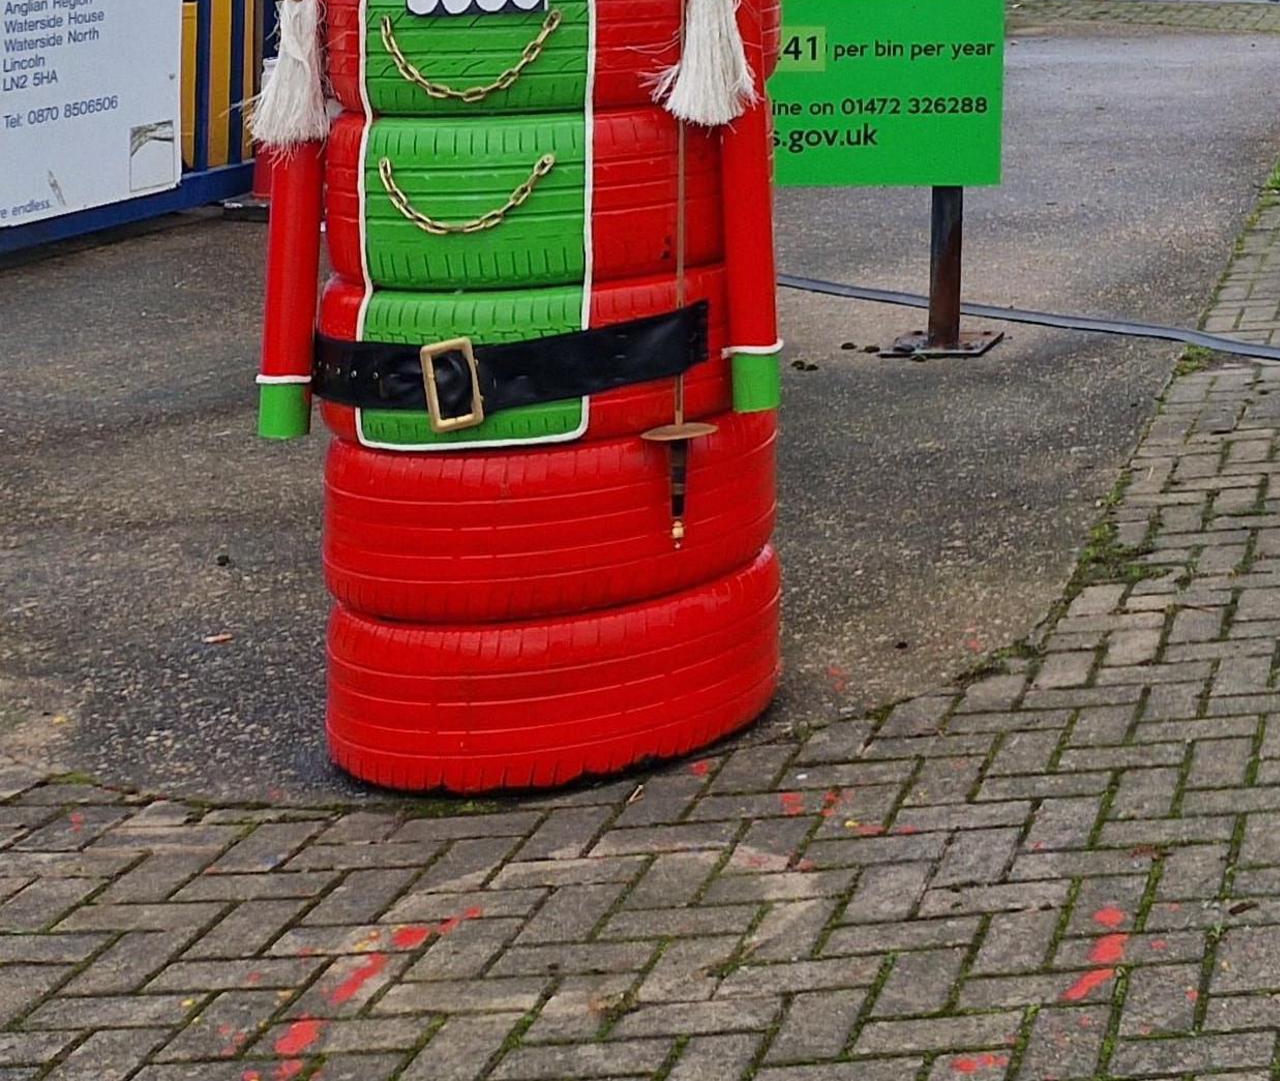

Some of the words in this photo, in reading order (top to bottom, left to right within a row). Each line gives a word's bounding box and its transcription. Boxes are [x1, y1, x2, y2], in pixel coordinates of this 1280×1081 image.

[5, 15, 64, 35] Waterside
[68, 10, 105, 25] House
[4, 33, 63, 53] Waterside
[67, 27, 100, 44] North
[833, 42, 868, 62] per
[874, 40, 904, 57] bin
[910, 42, 945, 61] per
[951, 41, 996, 60] year
[3, 54, 46, 72] Lincoln
[3, 74, 29, 92] LN2
[32, 70, 59, 86] 5HA
[3, 113, 23, 129] Tel:
[27, 106, 60, 125] 0870
[64, 95, 119, 119] 8506506
[772, 99, 803, 116] ine
[809, 102, 834, 116] on
[841, 97, 901, 115] 01472
[907, 96, 988, 114] 326288
[773, 122, 879, 154] s.gov.uk
